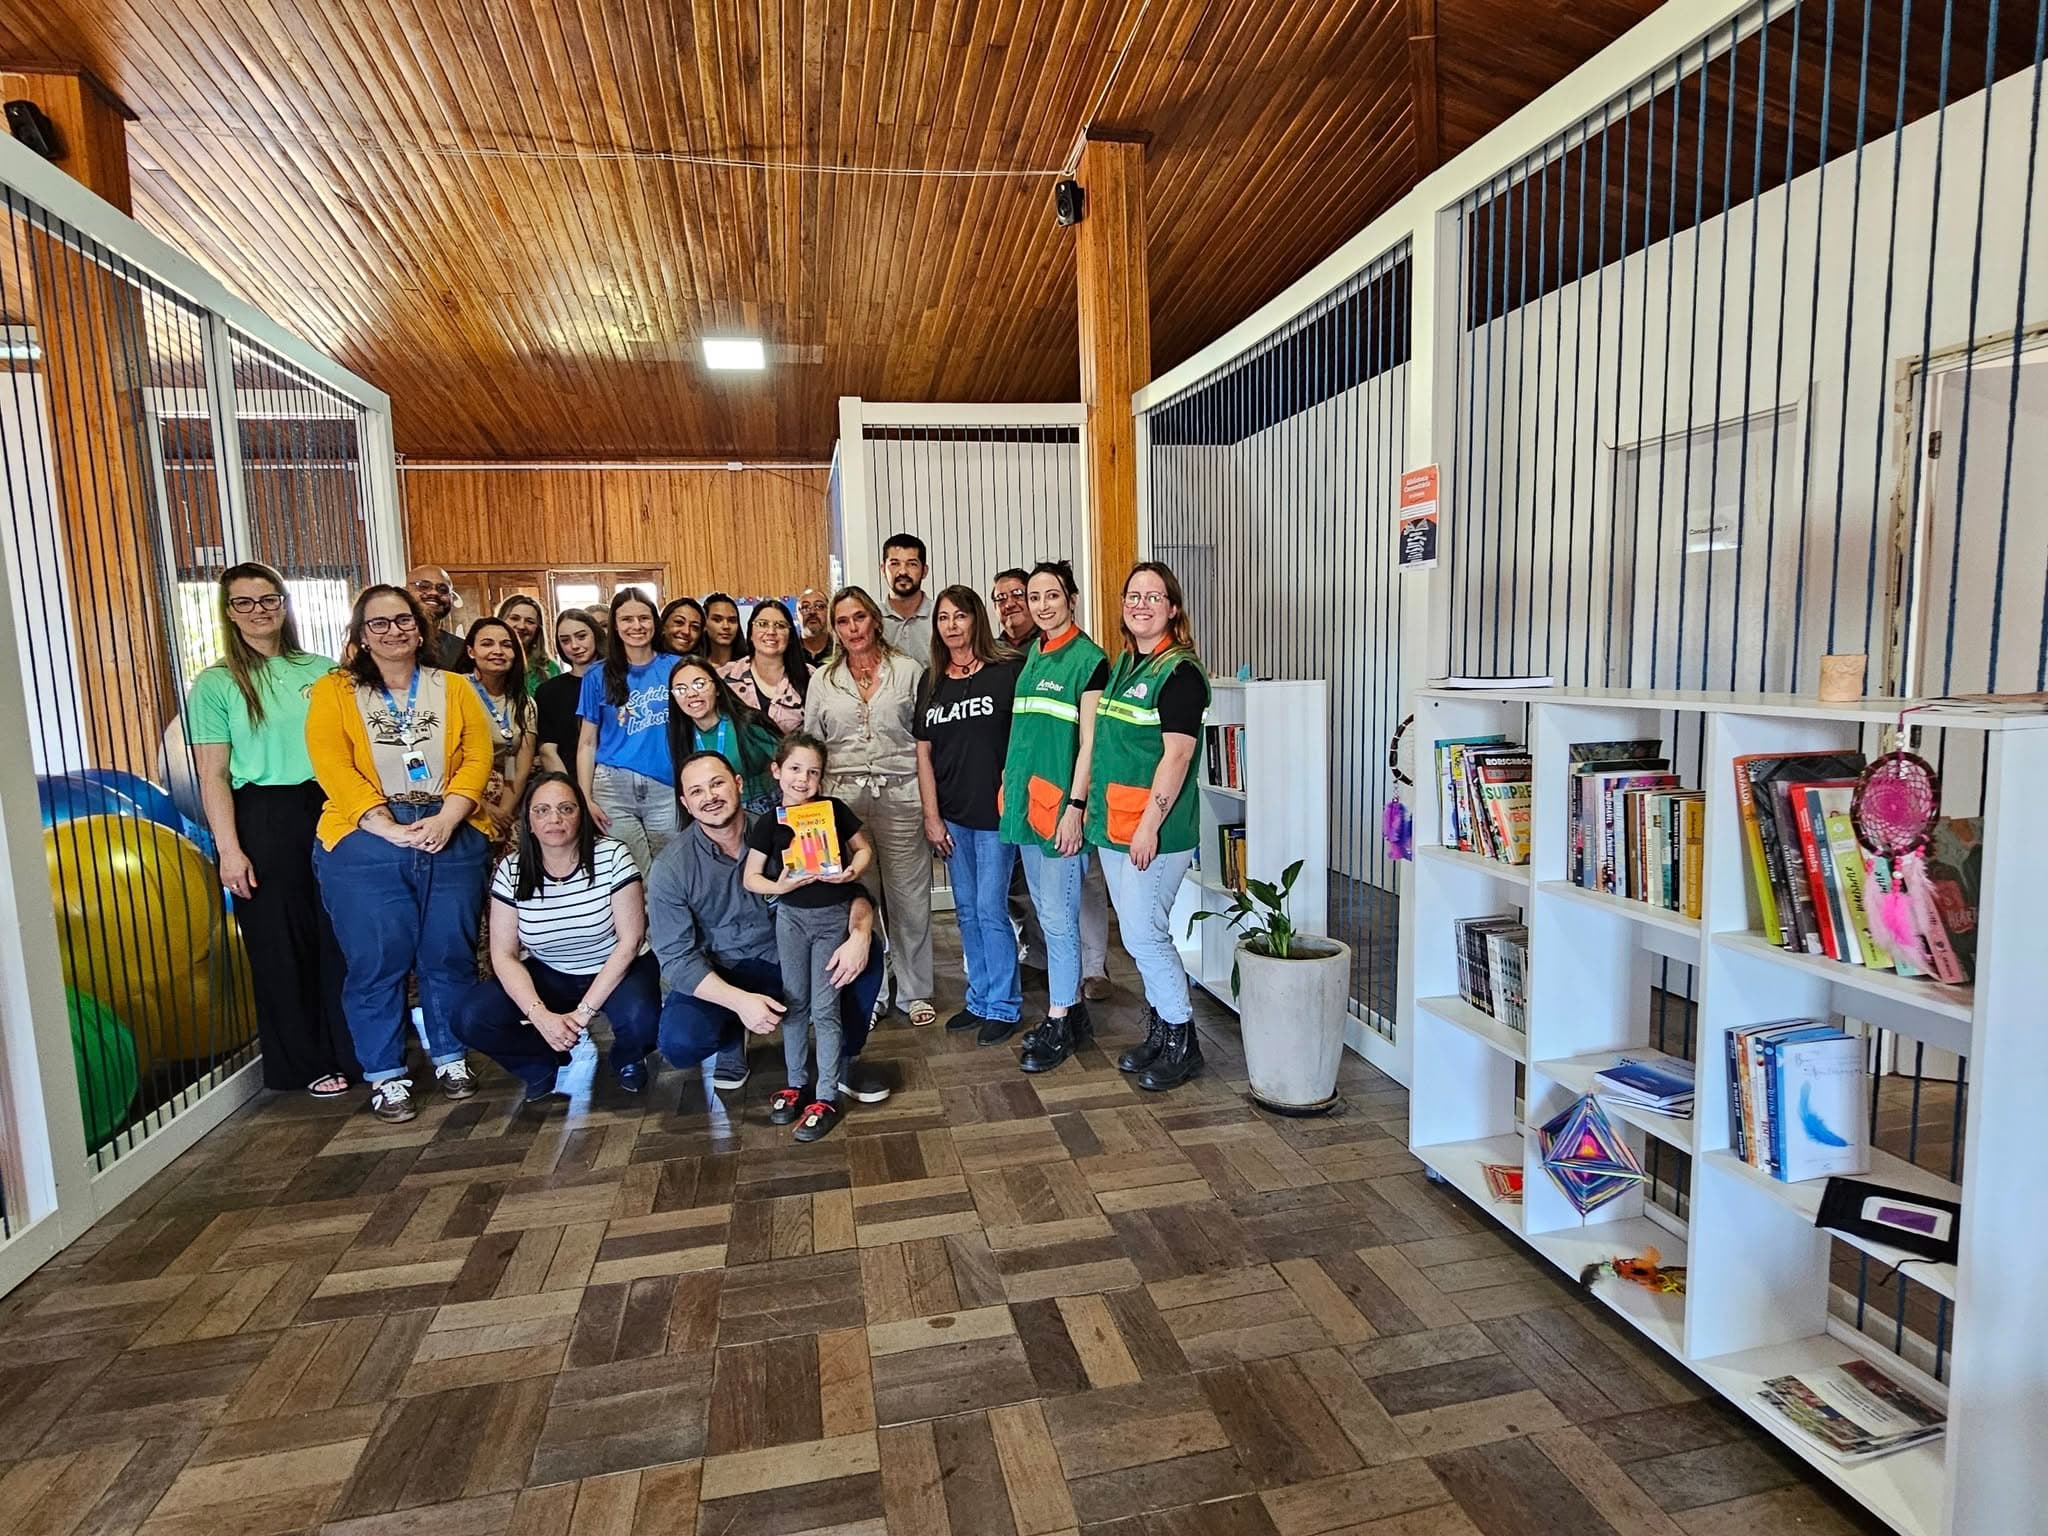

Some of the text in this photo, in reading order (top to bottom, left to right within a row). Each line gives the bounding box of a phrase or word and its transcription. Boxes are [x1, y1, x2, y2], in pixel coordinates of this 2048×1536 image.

[925, 695, 994, 728] PILATES
[1807, 844, 1819, 873] Sapiens
[1821, 848, 1833, 877] Sapiens
